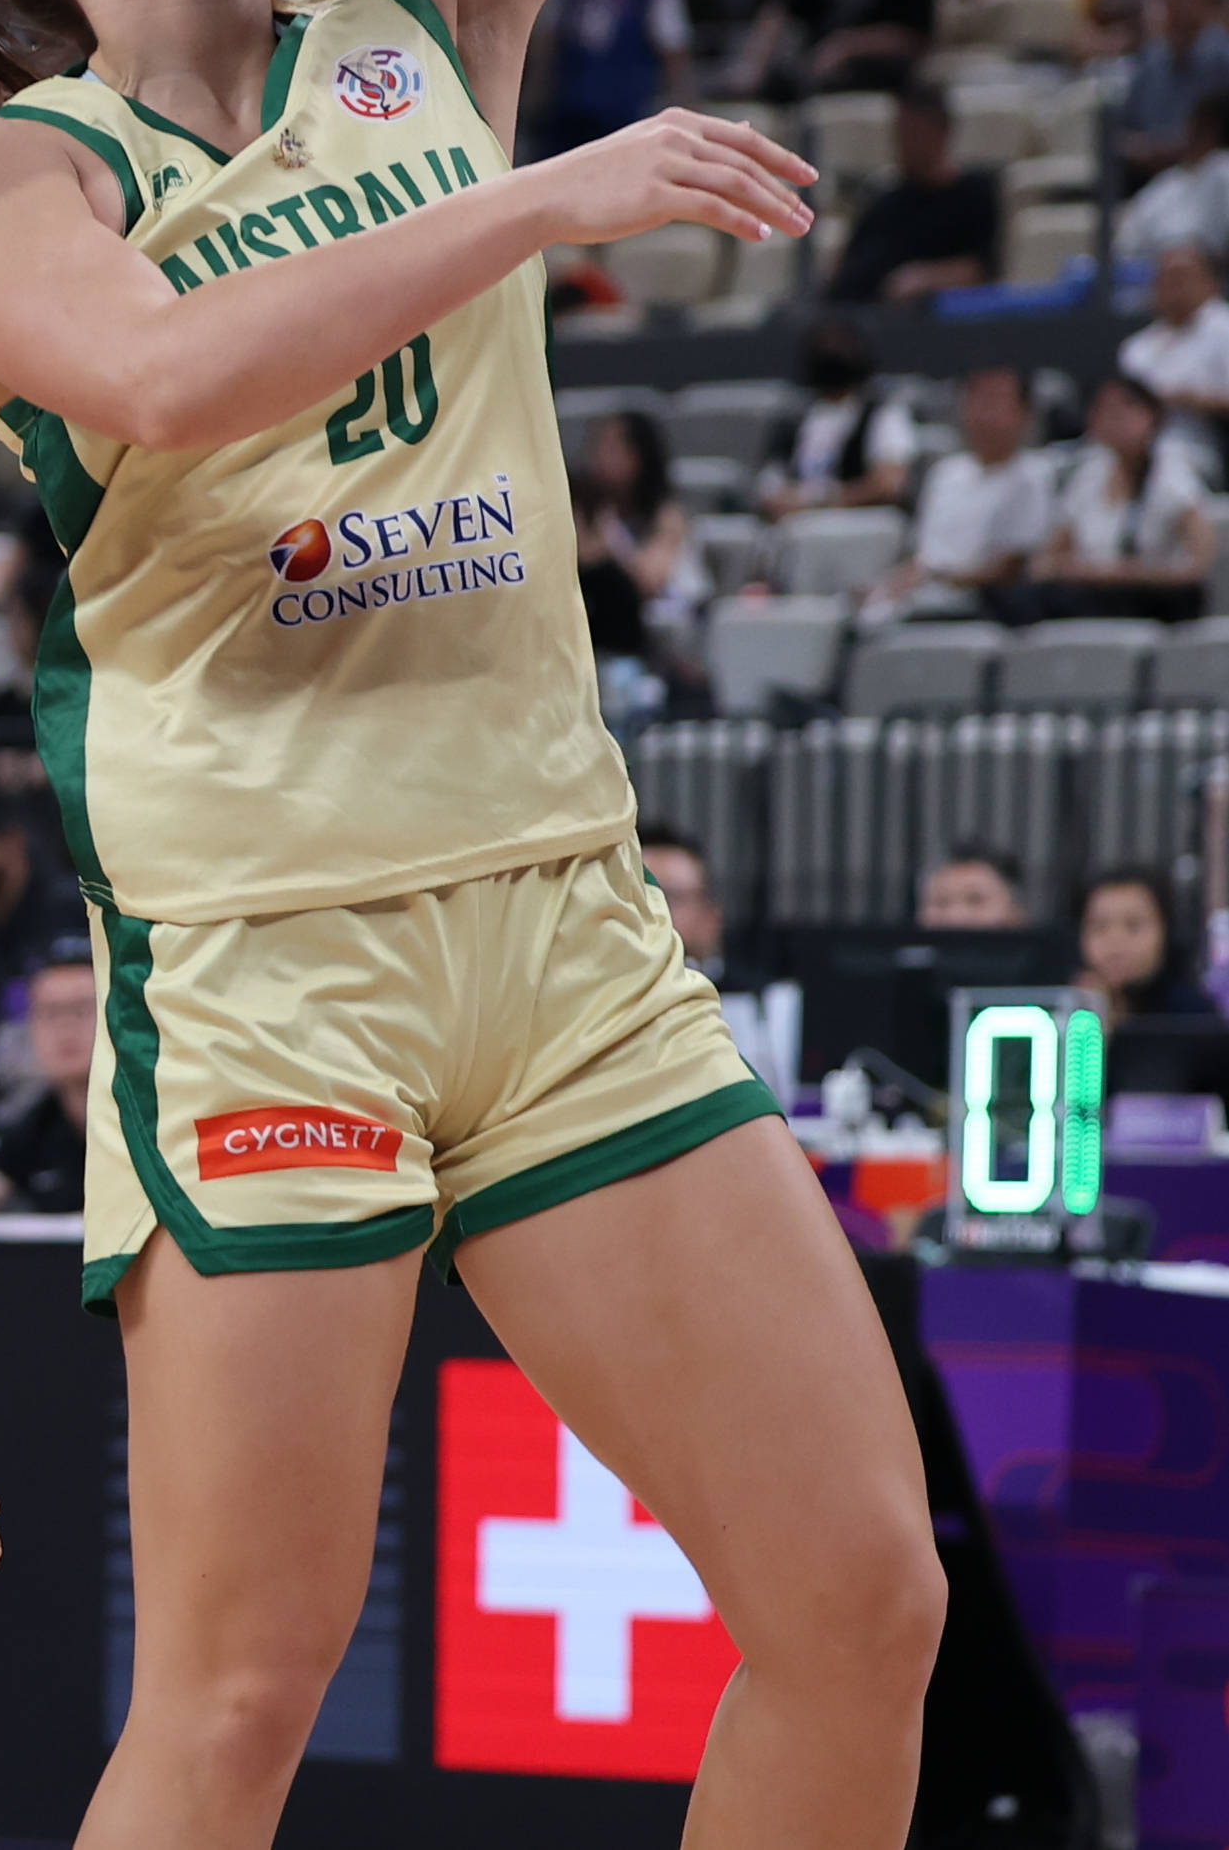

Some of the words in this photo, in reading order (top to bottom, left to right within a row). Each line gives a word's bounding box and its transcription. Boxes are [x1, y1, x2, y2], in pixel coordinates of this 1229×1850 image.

[325, 331, 439, 466] 20
[338, 490, 514, 569] SEVEN
[272, 551, 524, 627] CONSULTING
[224, 1122, 387, 1155] CYGNETT
